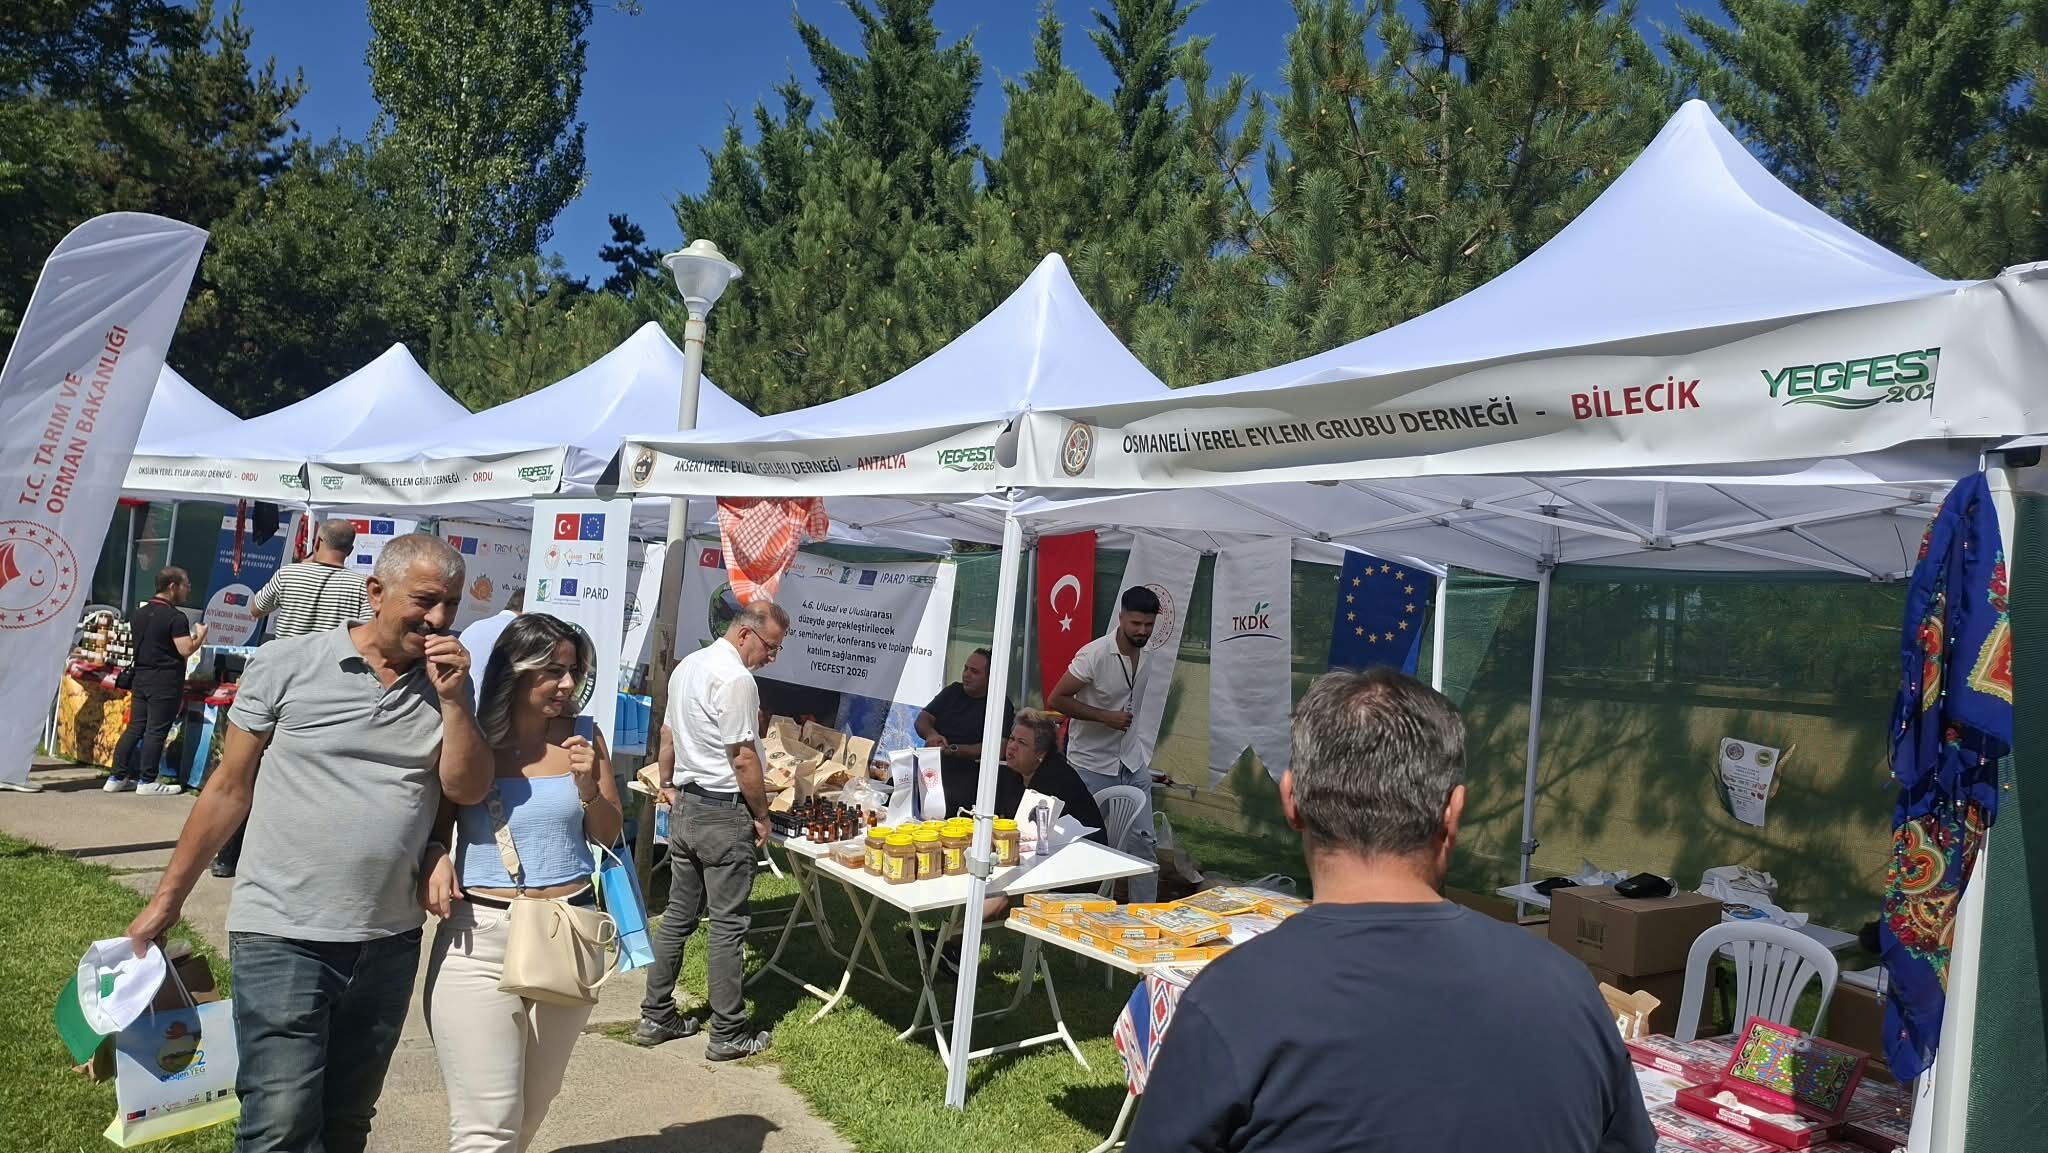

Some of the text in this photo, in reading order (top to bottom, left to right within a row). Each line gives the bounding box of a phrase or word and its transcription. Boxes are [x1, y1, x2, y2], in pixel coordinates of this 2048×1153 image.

[47, 325, 129, 514] ORMAN BAKANLIĞI
[1123, 428, 1191, 453] OSMANELİ
[1191, 429, 1247, 451] YEREL
[1245, 423, 1315, 447] EYLEM
[1315, 414, 1397, 441] GRUBU
[1398, 395, 1519, 433] DERNEĞİ
[1571, 375, 1701, 420] BİLECİK
[19, 372, 83, 505] T.C. TARIM VE
[673, 458, 703, 473] AKSEKİ
[703, 459, 729, 473] YEREL
[731, 460, 758, 474] EYLEM
[758, 462, 792, 475] GRUBU
[791, 456, 842, 475] DERNEĞİ
[857, 454, 906, 471] ANTALYA
[937, 446, 996, 465] YEGFEST
[517, 464, 553, 478] YEGFEST
[971, 462, 996, 471] 2026
[241, 471, 259, 482] ORDU
[391, 477, 414, 487] EYLEM
[472, 472, 494, 483] ORDU
[816, 567, 833, 576] TKDK
[880, 572, 906, 584] IPARD
[583, 587, 609, 600] IPARD
[816, 601, 839, 614] Ulusal
[848, 606, 893, 620] Uluslararası
[798, 615, 896, 637] düzeyde gerçekleştirilecek
[1232, 614, 1270, 631] TKDK
[806, 644, 877, 665] katılım sağlanması
[837, 635, 876, 650] konferans
[877, 642, 888, 650] ve
[888, 642, 933, 657] toplantılara
[810, 660, 869, 680] (YEGFEST 2026)
